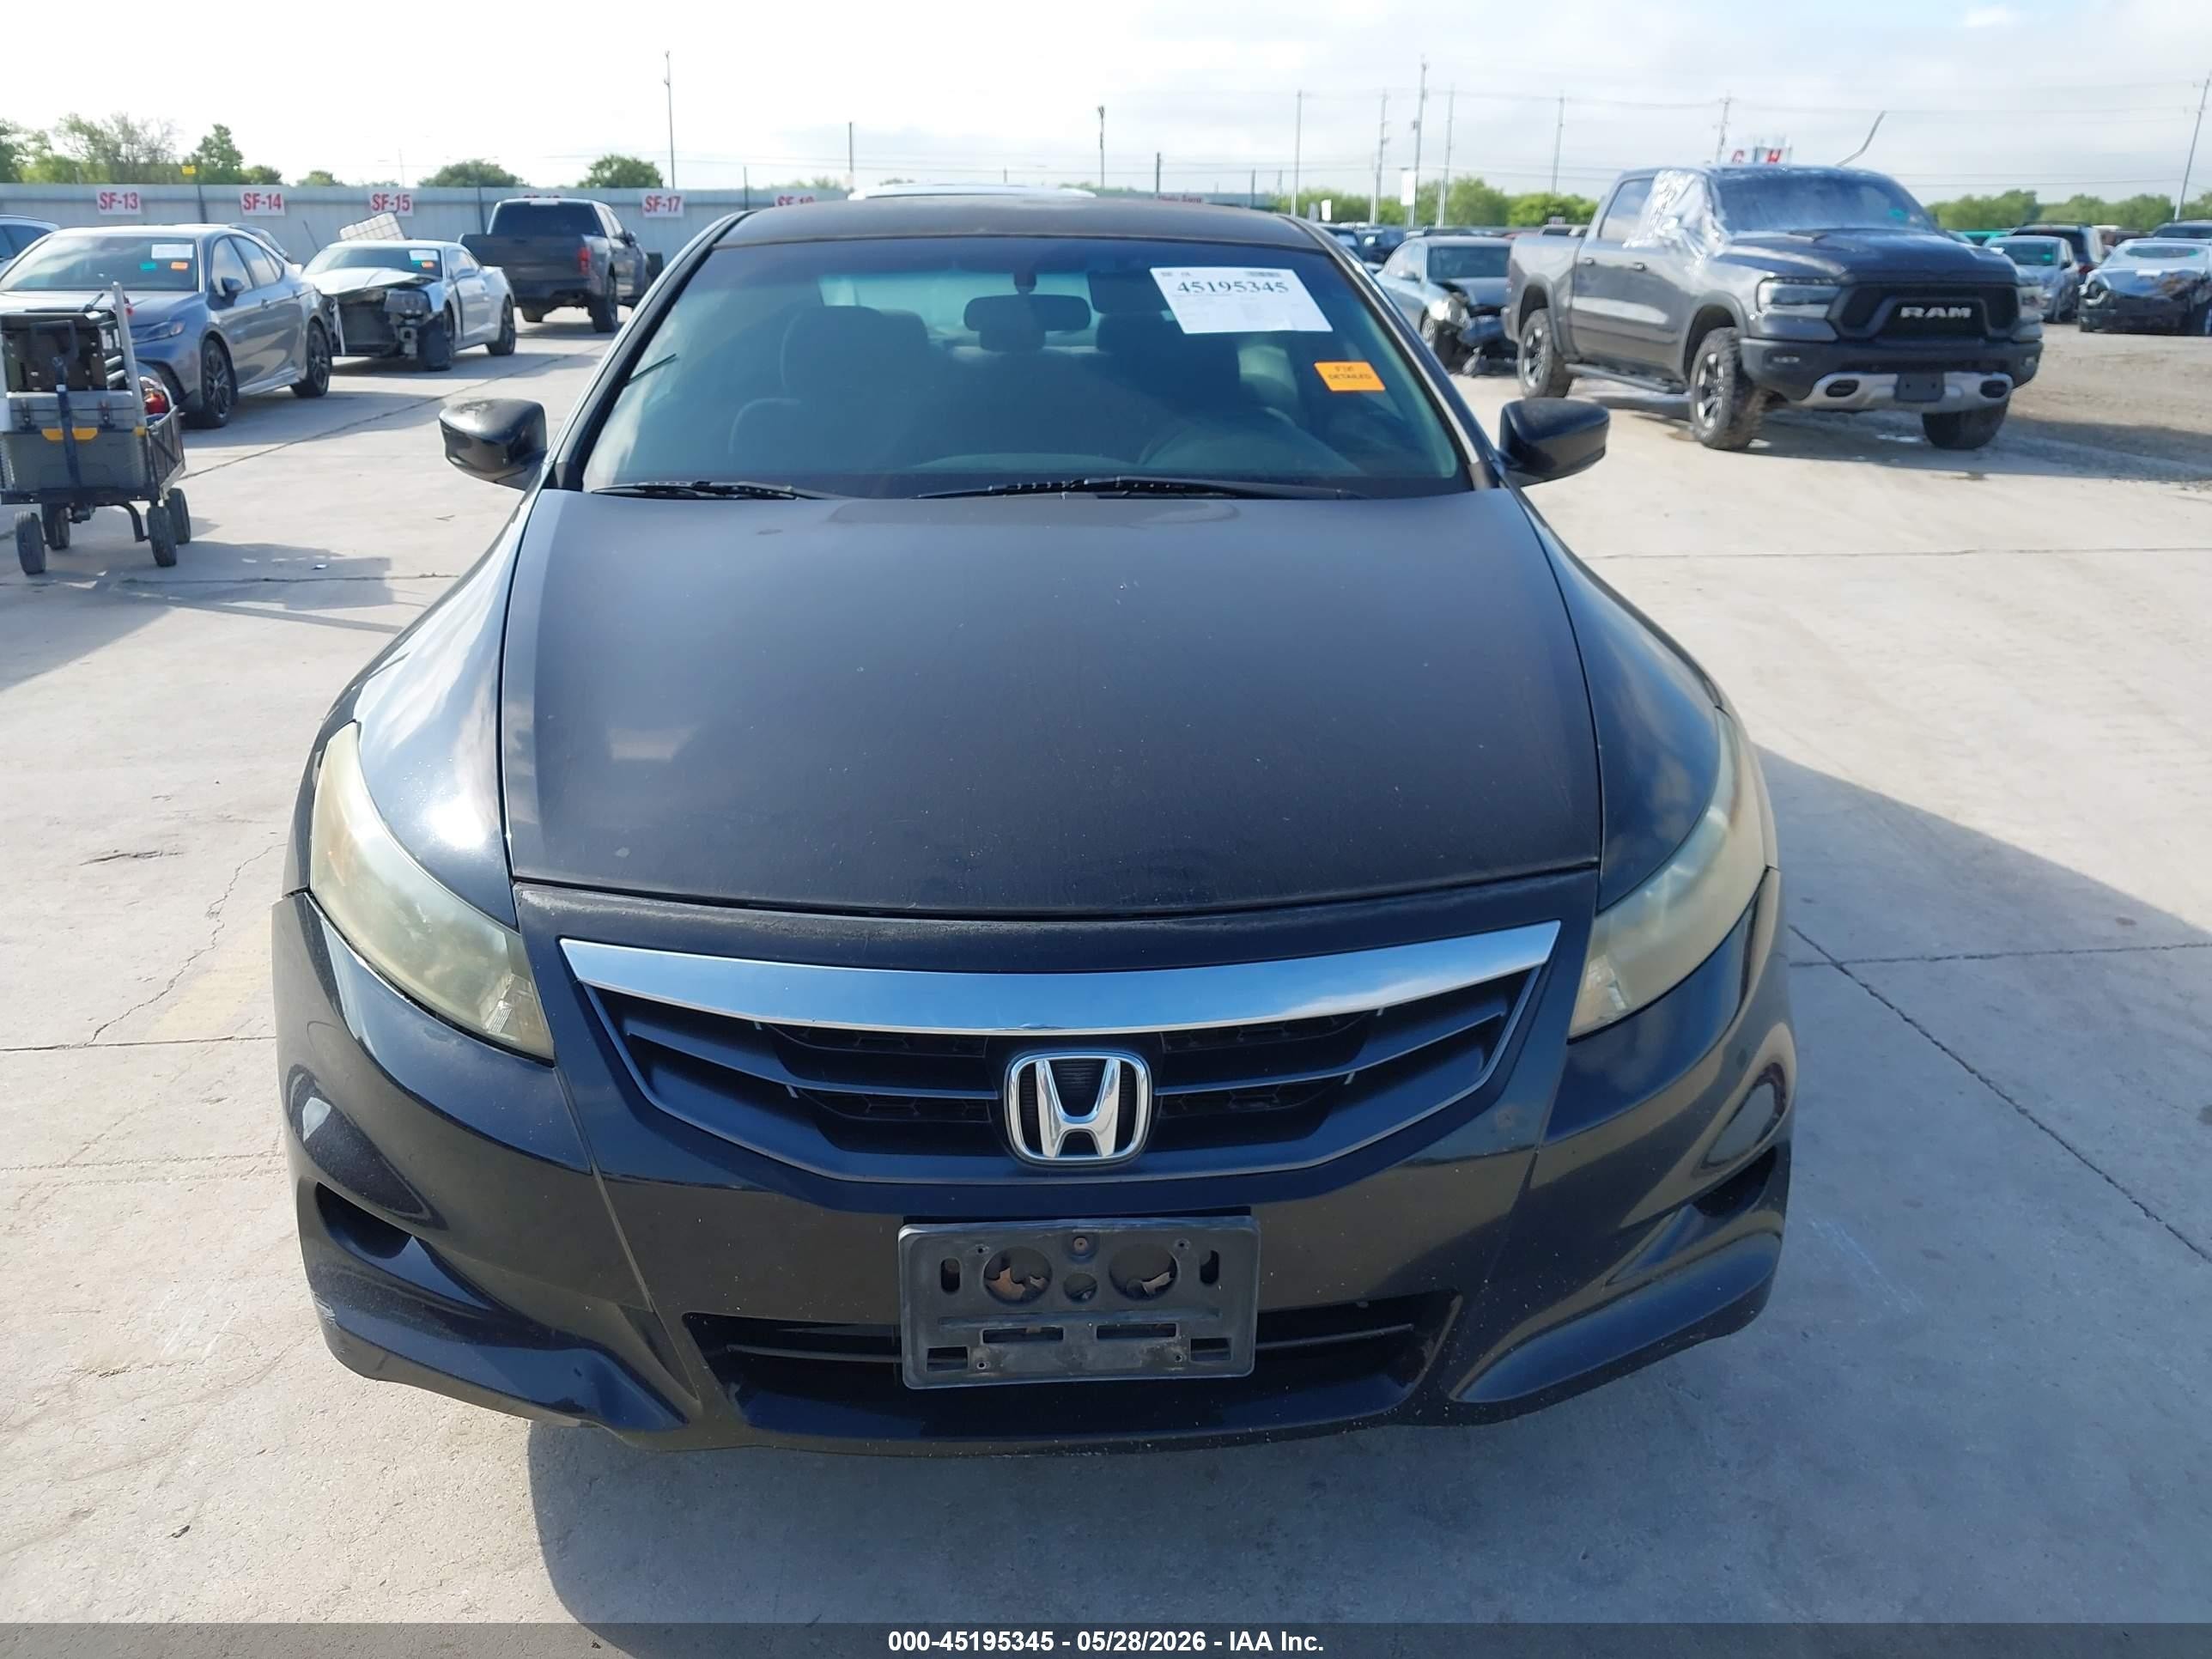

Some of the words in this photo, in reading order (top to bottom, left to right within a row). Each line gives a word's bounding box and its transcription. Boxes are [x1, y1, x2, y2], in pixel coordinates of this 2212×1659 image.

[99, 191, 138, 210] SF-13
[243, 192, 282, 210] SF-14
[372, 193, 410, 211] SF-15
[645, 195, 682, 212] SF-17
[1177, 281, 1289, 294] 45195345
[1899, 307, 1972, 319] RAM
